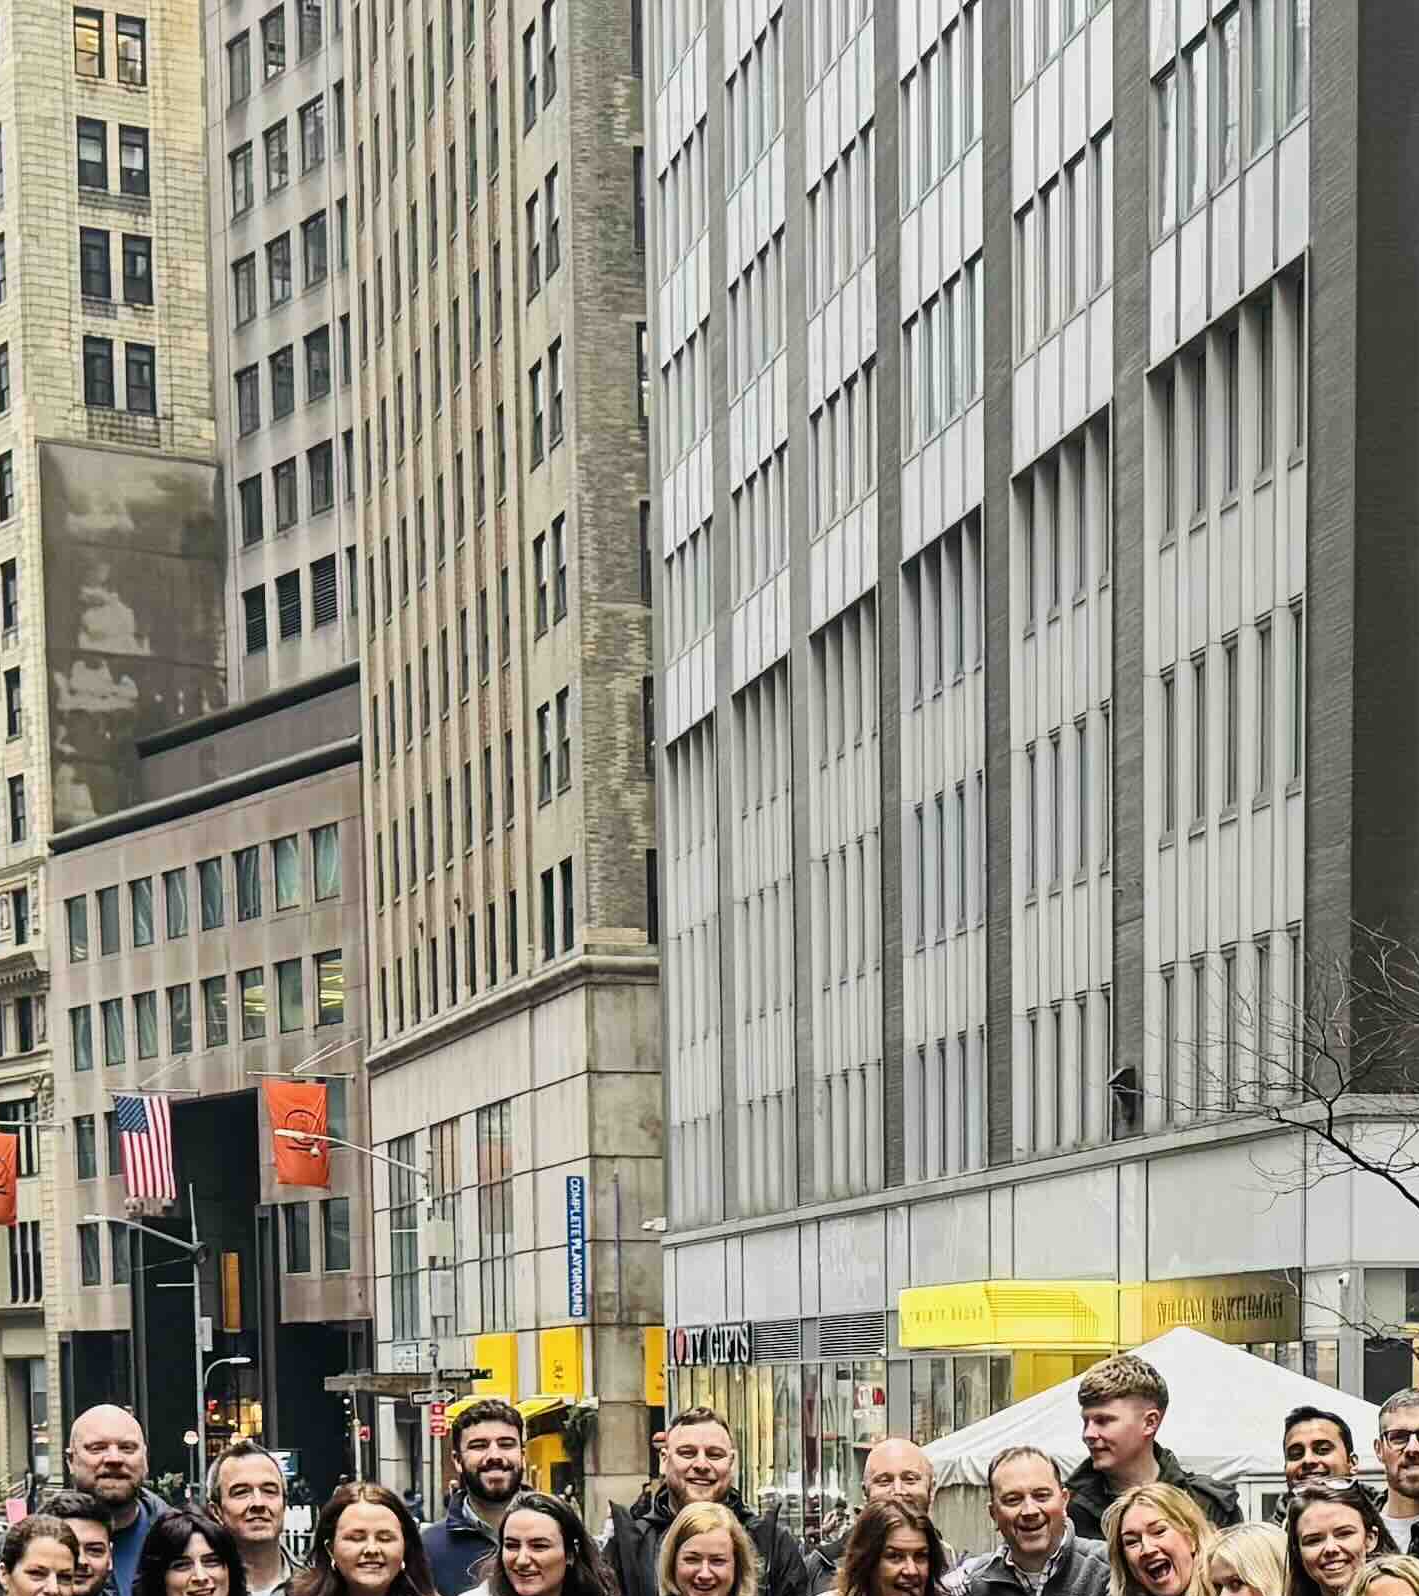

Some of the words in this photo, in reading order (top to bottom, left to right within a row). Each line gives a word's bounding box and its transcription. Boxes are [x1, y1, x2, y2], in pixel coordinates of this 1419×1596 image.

[1157, 1297, 1206, 1326] WILLIAM
[1211, 1290, 1283, 1323] BARTHMAN
[709, 1324, 749, 1363] GIFTS
